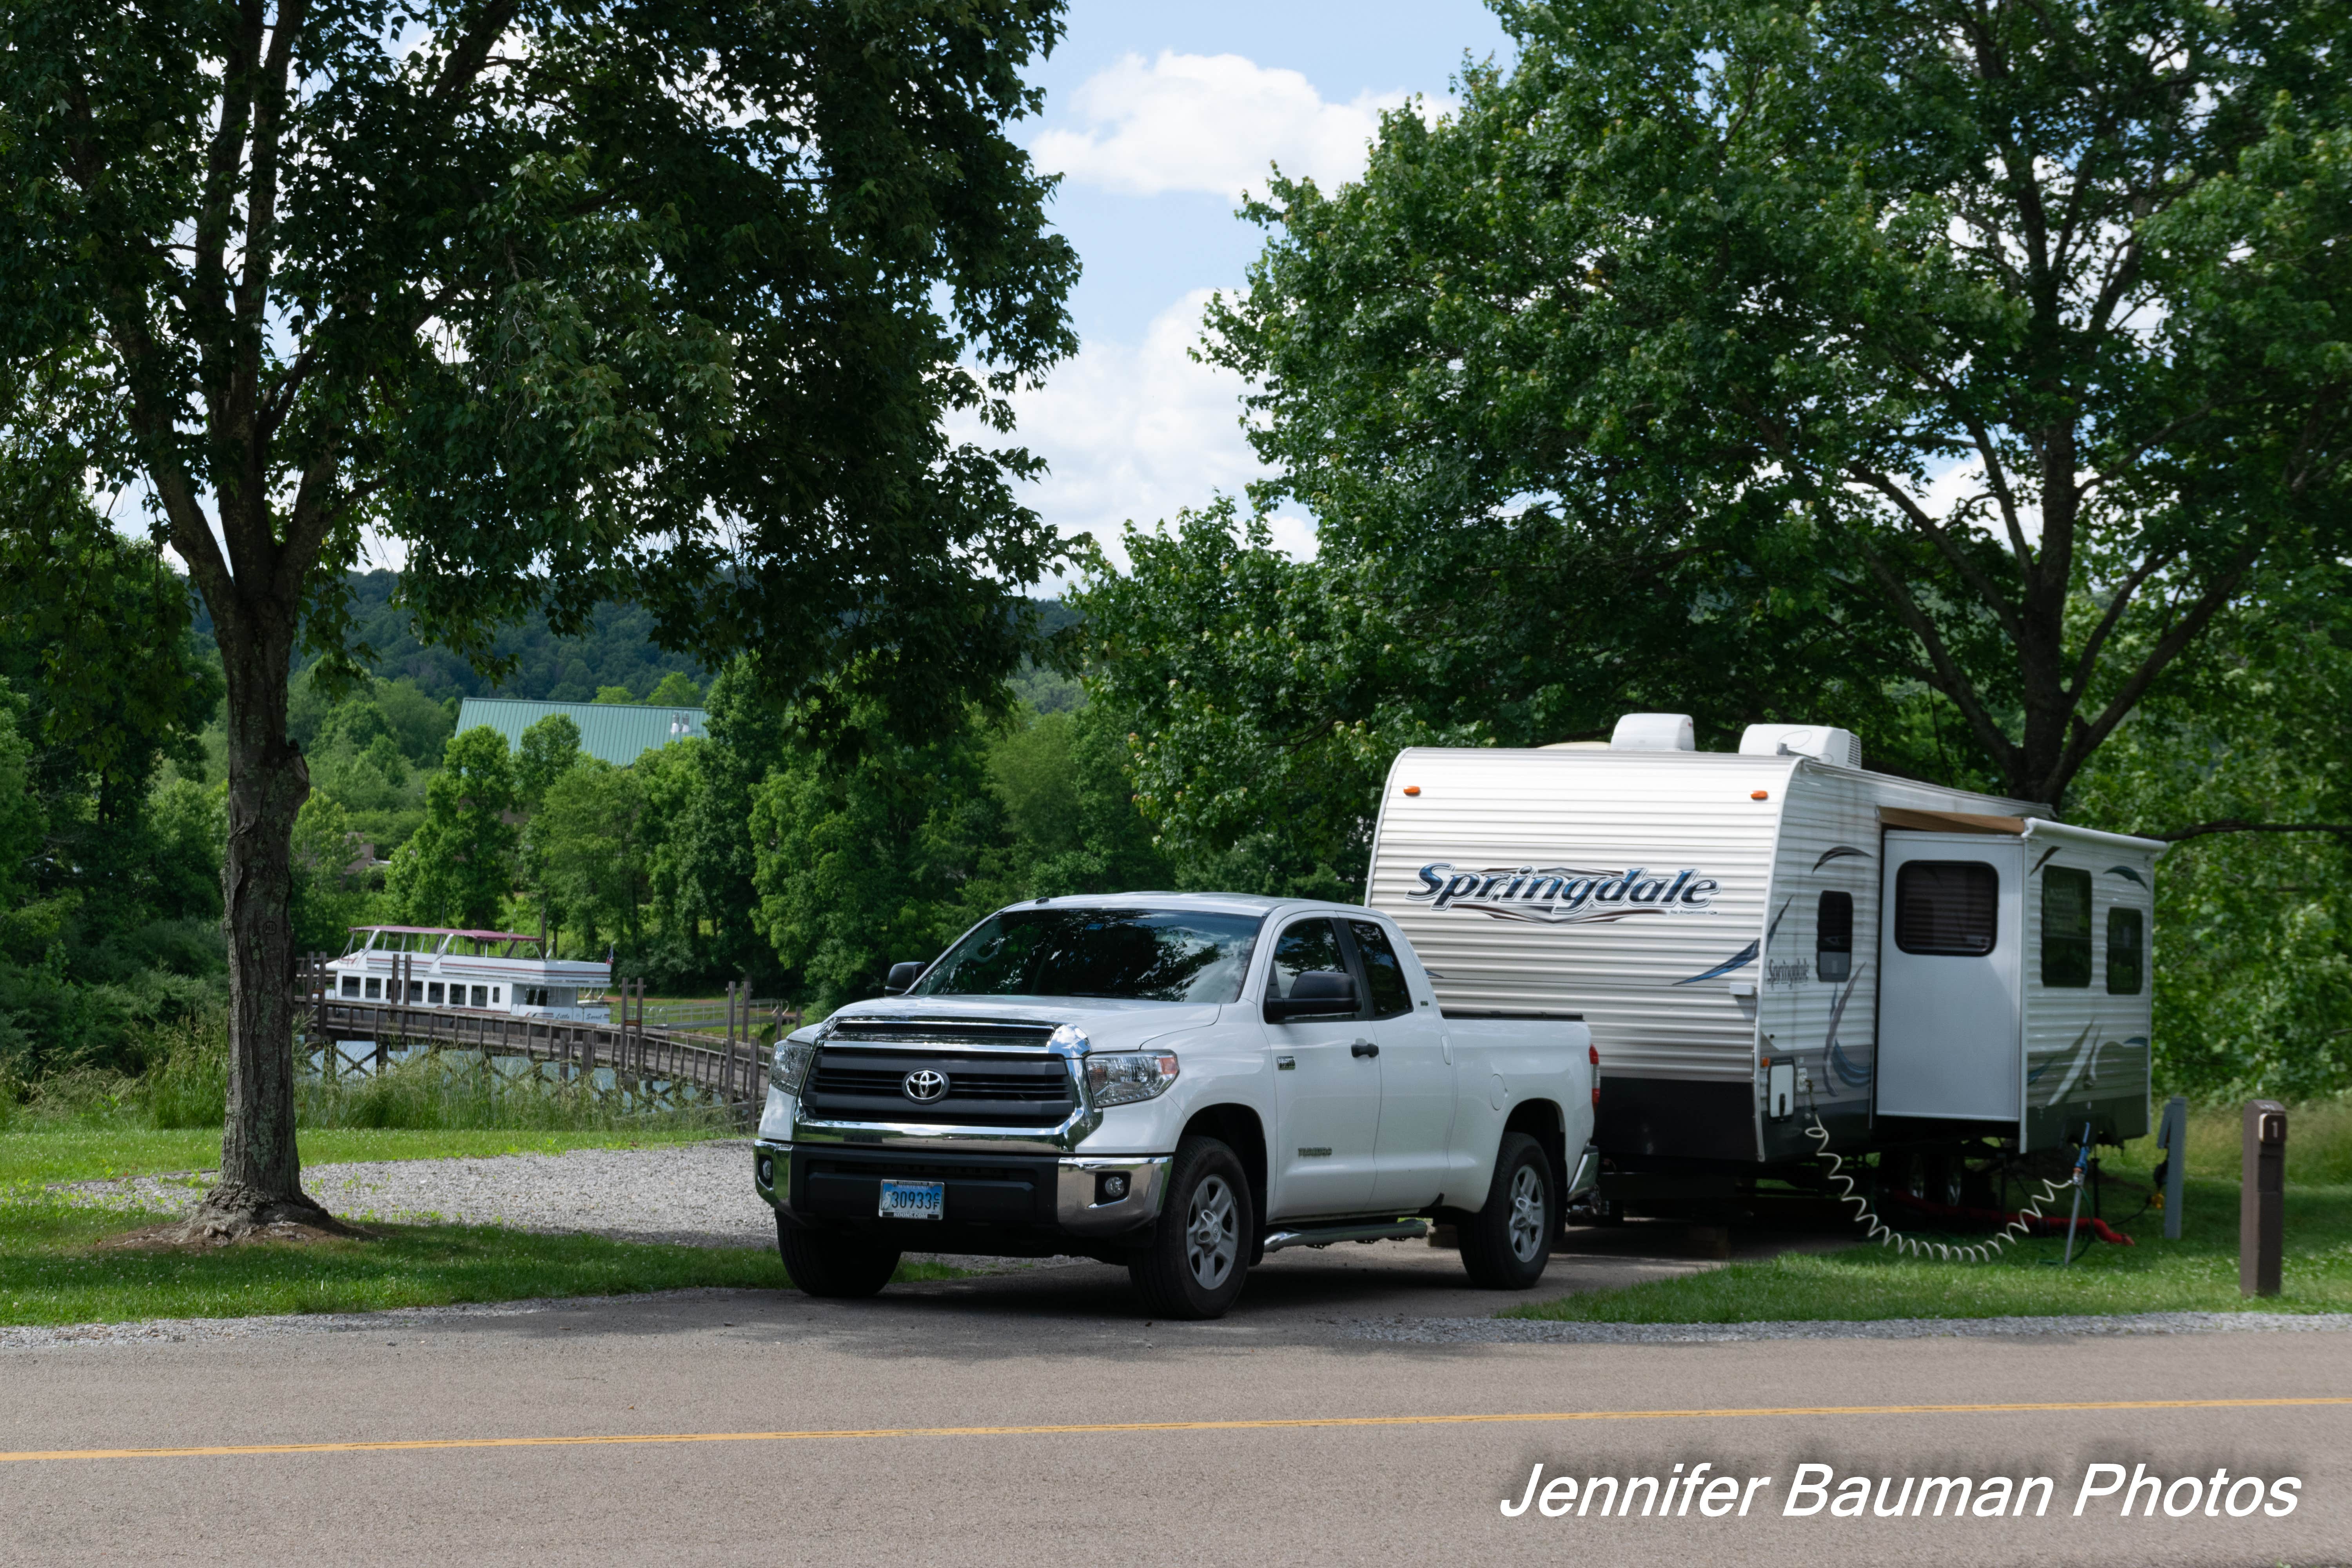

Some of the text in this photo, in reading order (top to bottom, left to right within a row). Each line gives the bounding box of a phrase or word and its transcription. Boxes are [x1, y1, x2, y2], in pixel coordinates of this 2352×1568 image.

[1406, 863, 1718, 915] Springdale
[1767, 958, 1809, 990] Springdale
[2272, 1121, 2278, 1138] 1
